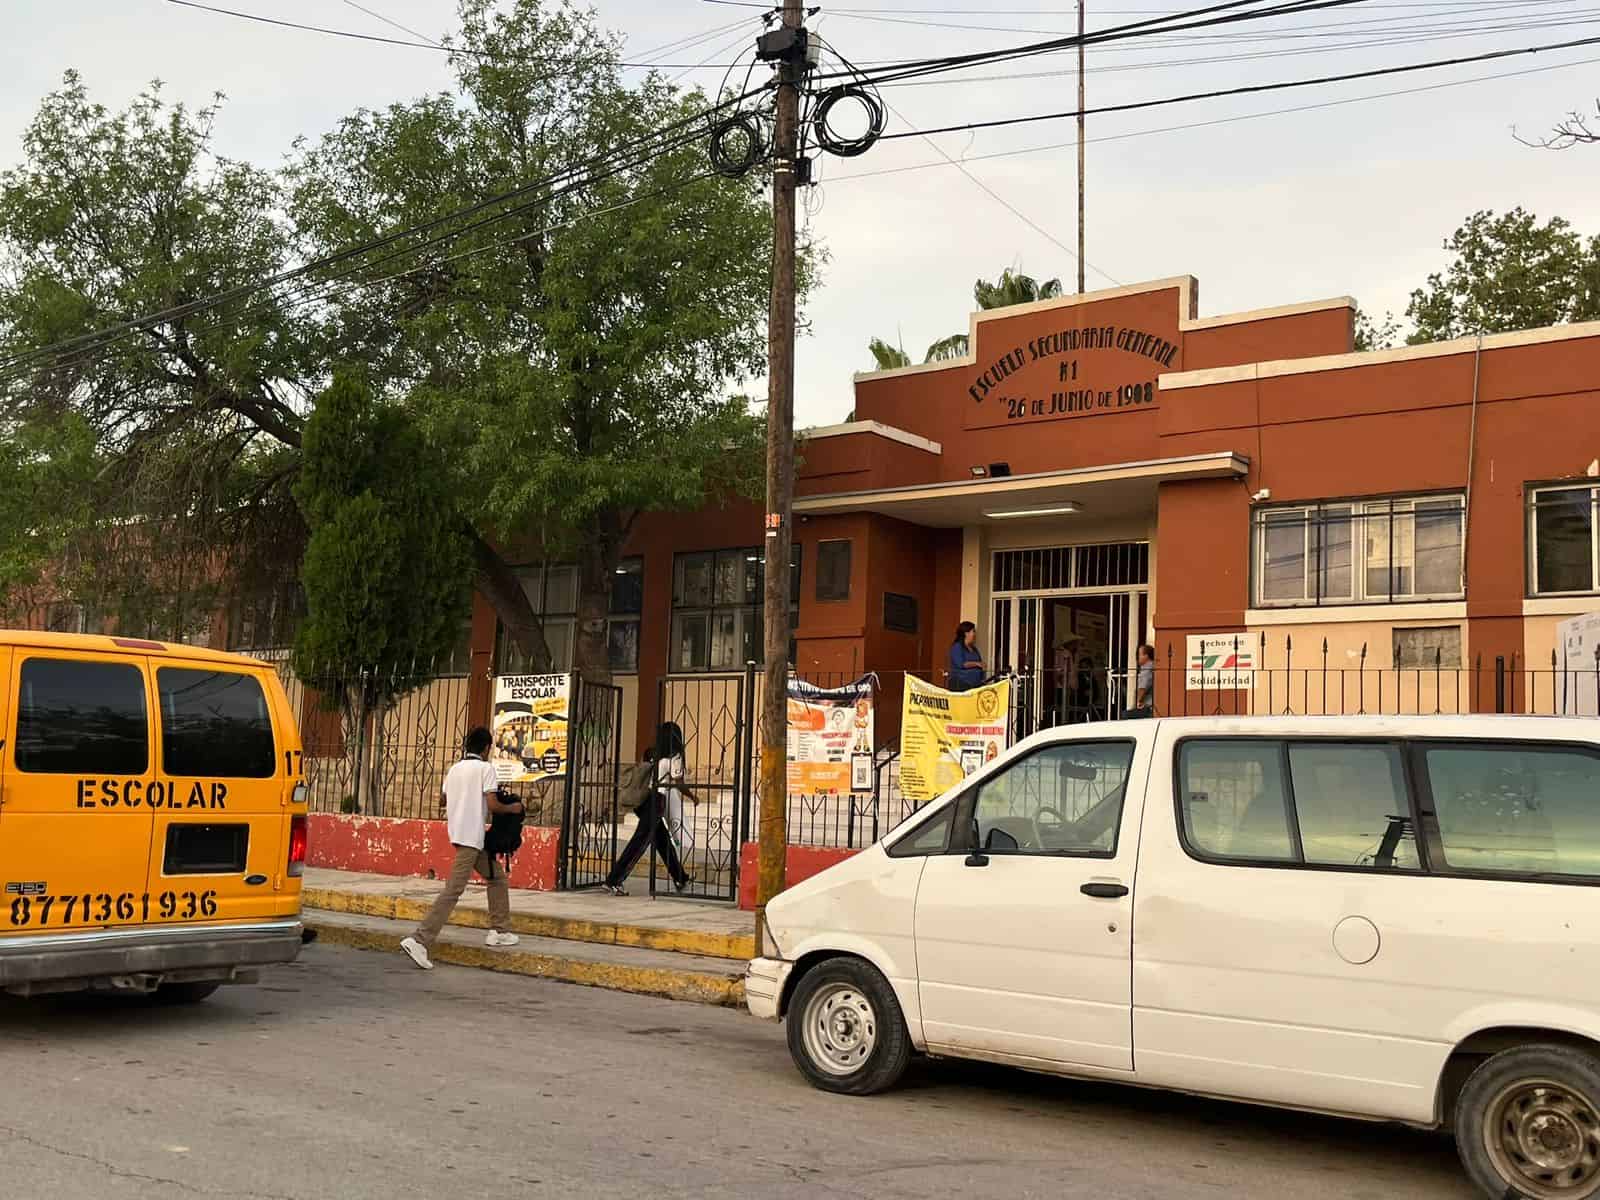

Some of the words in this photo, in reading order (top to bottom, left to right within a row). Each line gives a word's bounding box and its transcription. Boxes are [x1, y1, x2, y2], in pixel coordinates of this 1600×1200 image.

[969, 348, 1025, 403] ESCUELA
[1028, 326, 1115, 361] SECUNDARIA
[1117, 328, 1178, 369] GENERAL
[1031, 400, 1044, 416] DE
[1048, 390, 1094, 415] JUNIO
[1098, 391, 1113, 407] DE
[1200, 640, 1227, 648] echo
[502, 675, 566, 689] TRANSPORTE
[511, 687, 556, 699] ESCOLAR
[1190, 675, 1250, 686] Solidriad
[285, 750, 304, 776] 17
[76, 780, 228, 809] ESCOLAR
[10, 890, 218, 926] 8771361936
